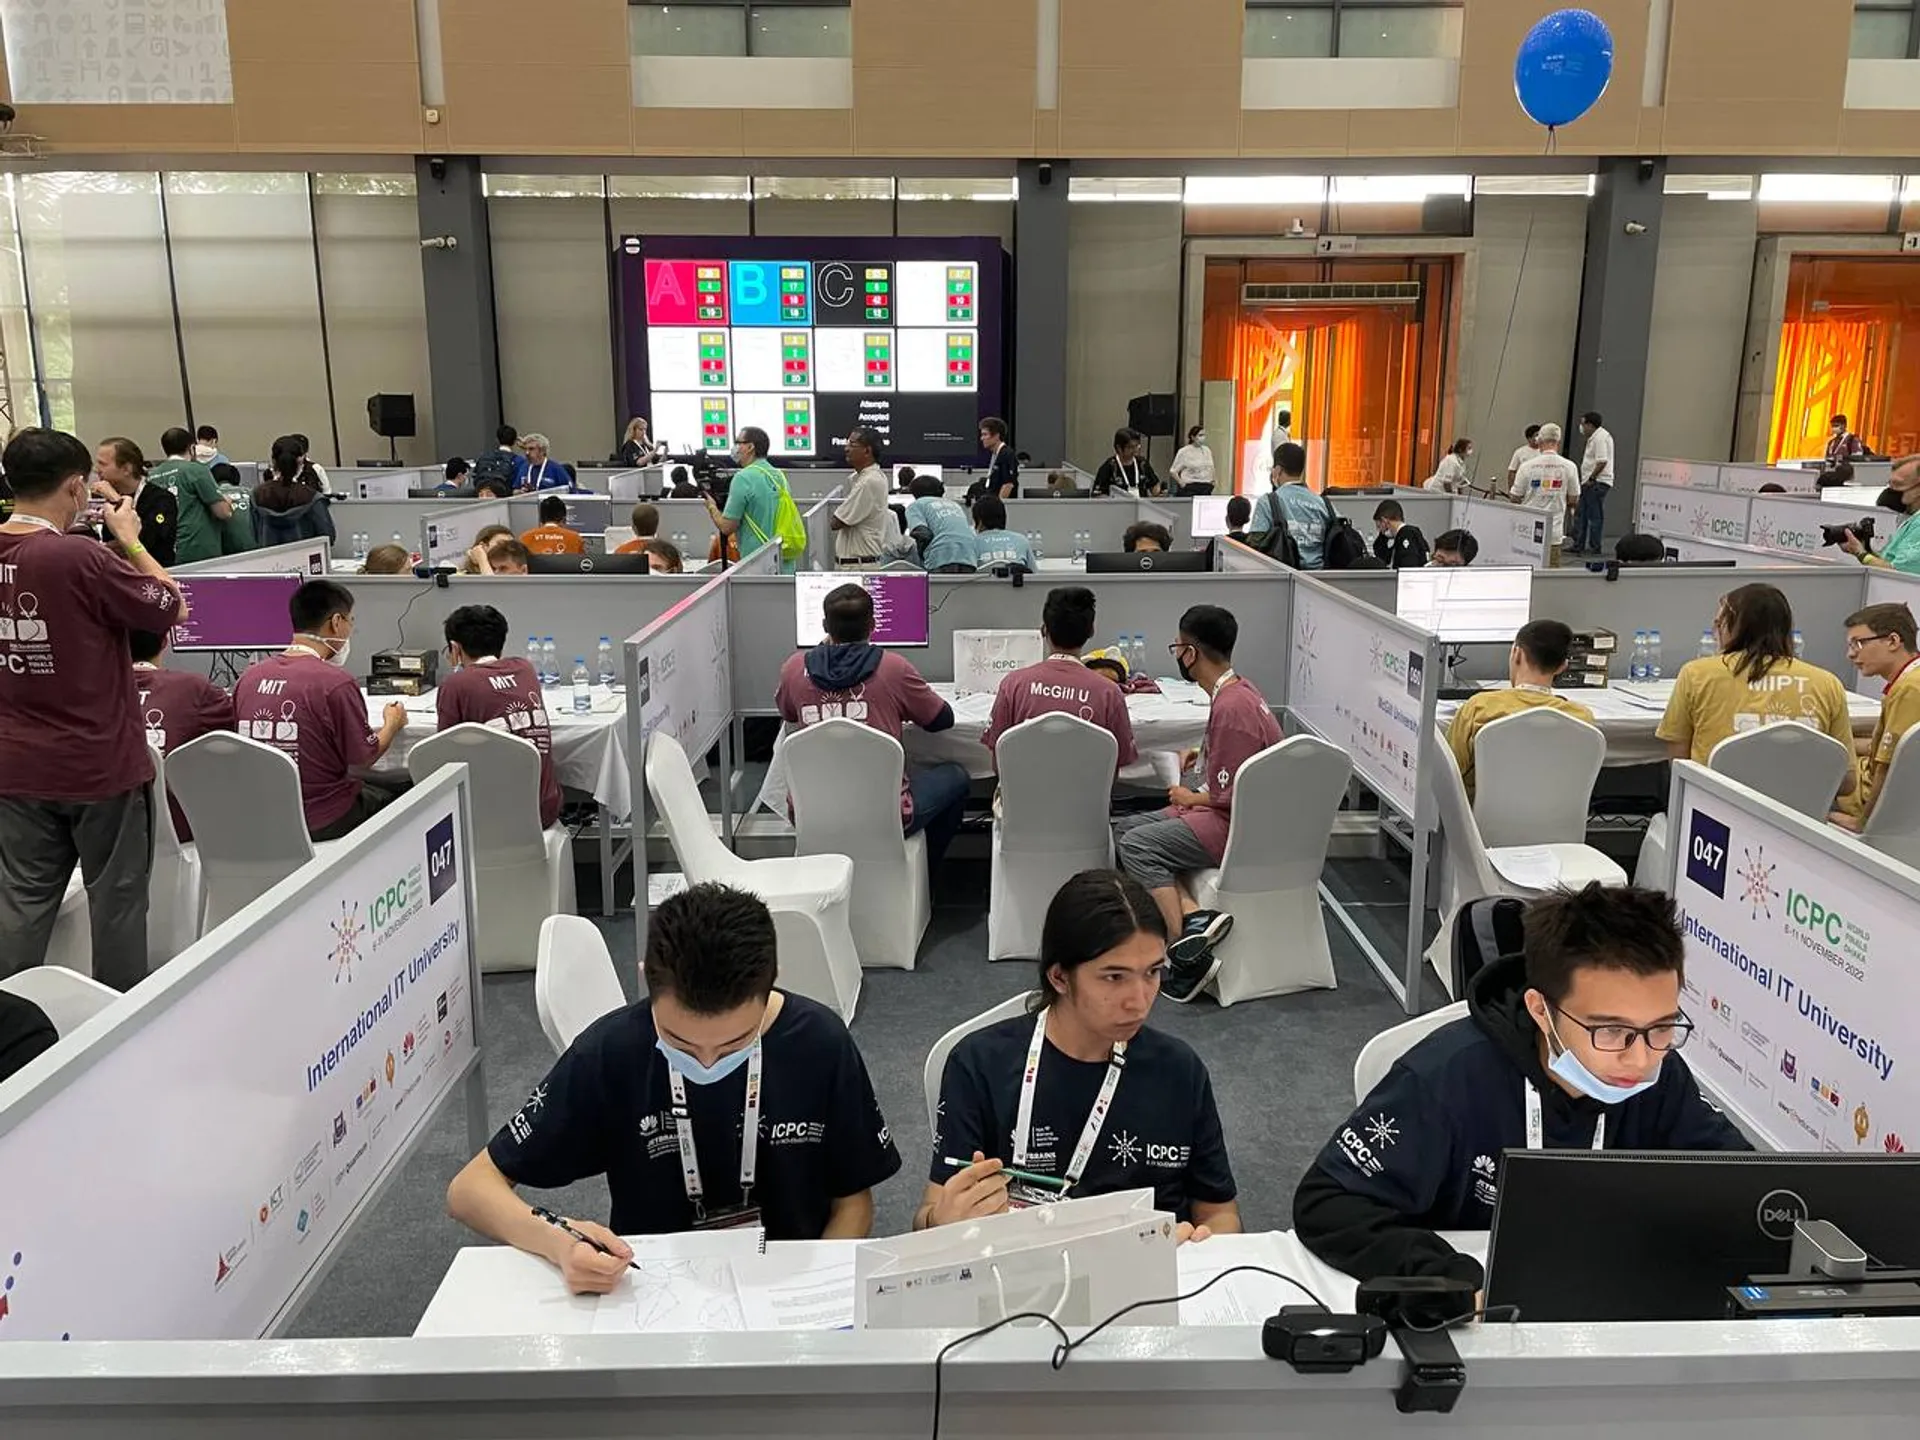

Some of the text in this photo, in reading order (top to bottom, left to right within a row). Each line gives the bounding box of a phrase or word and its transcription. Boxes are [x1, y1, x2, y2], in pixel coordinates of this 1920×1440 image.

[650, 262, 686, 305] A
[736, 264, 768, 305] B
[817, 262, 854, 307] C
[858, 413, 890, 422] Accepted
[1711, 518, 1735, 536] ICPC
[1776, 530, 1804, 548] ICPC
[992, 660, 1016, 669] ICPC
[257, 679, 287, 695] MIT
[488, 675, 518, 690] MIT
[1030, 682, 1090, 703] McGill U
[431, 839, 452, 878] 047
[1693, 835, 1724, 871] 047
[370, 878, 407, 935] ICPC
[1786, 888, 1842, 945] ICPC
[1801, 933, 1845, 968] NOVEMBER
[1844, 962, 1865, 982] 2022
[307, 984, 393, 1092] International
[394, 970, 407, 1000] IT
[408, 920, 460, 984] University
[1681, 907, 1773, 991] International
[1777, 974, 1794, 1003] IT
[1798, 988, 1895, 1082] University
[771, 1122, 808, 1139] ICPC
[1341, 1127, 1372, 1162] ICPC
[1147, 1143, 1179, 1160] ICPC
[1764, 1209, 1800, 1222] DELL
